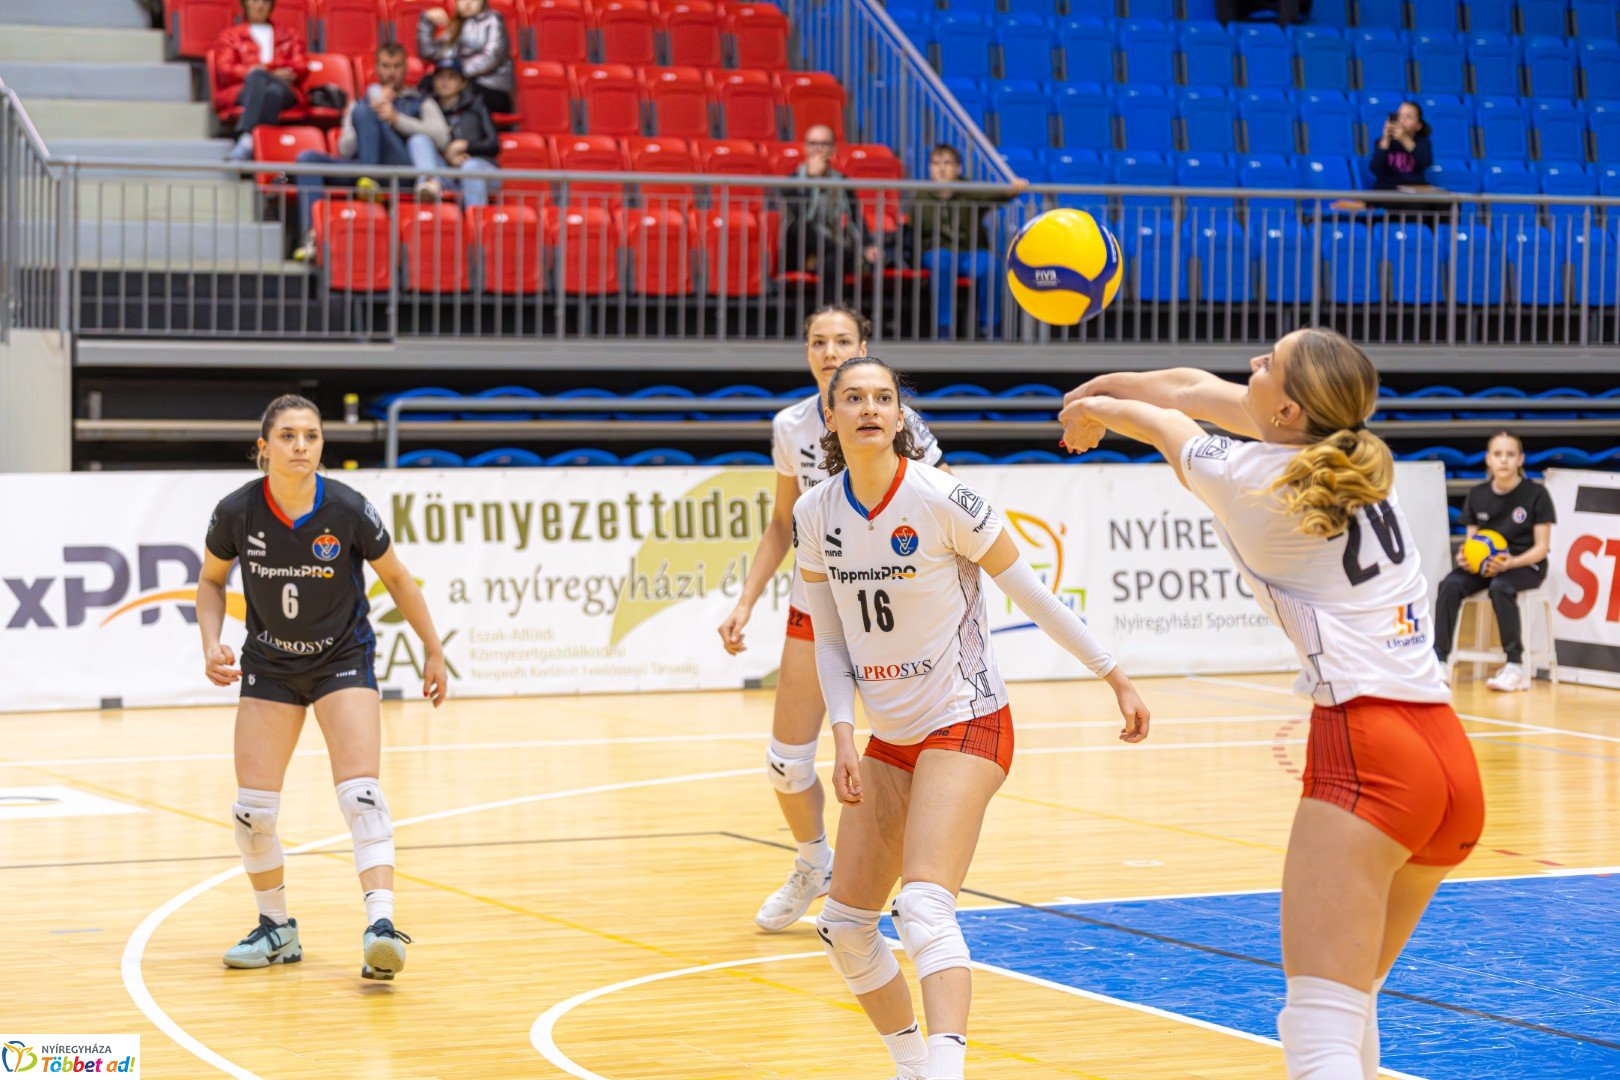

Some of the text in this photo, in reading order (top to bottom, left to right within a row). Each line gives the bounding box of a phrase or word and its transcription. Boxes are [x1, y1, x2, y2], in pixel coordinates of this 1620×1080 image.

[825, 549, 843, 558] nine
[1327, 498, 1405, 587] 20
[2, 544, 241, 629] xPR
[249, 561, 335, 579] TippmixPRO
[449, 576, 467, 603] a
[485, 556, 708, 616] nyíregyházi
[828, 564, 917, 584] TippmixPRO
[281, 582, 299, 620] 6
[857, 588, 895, 633] 16
